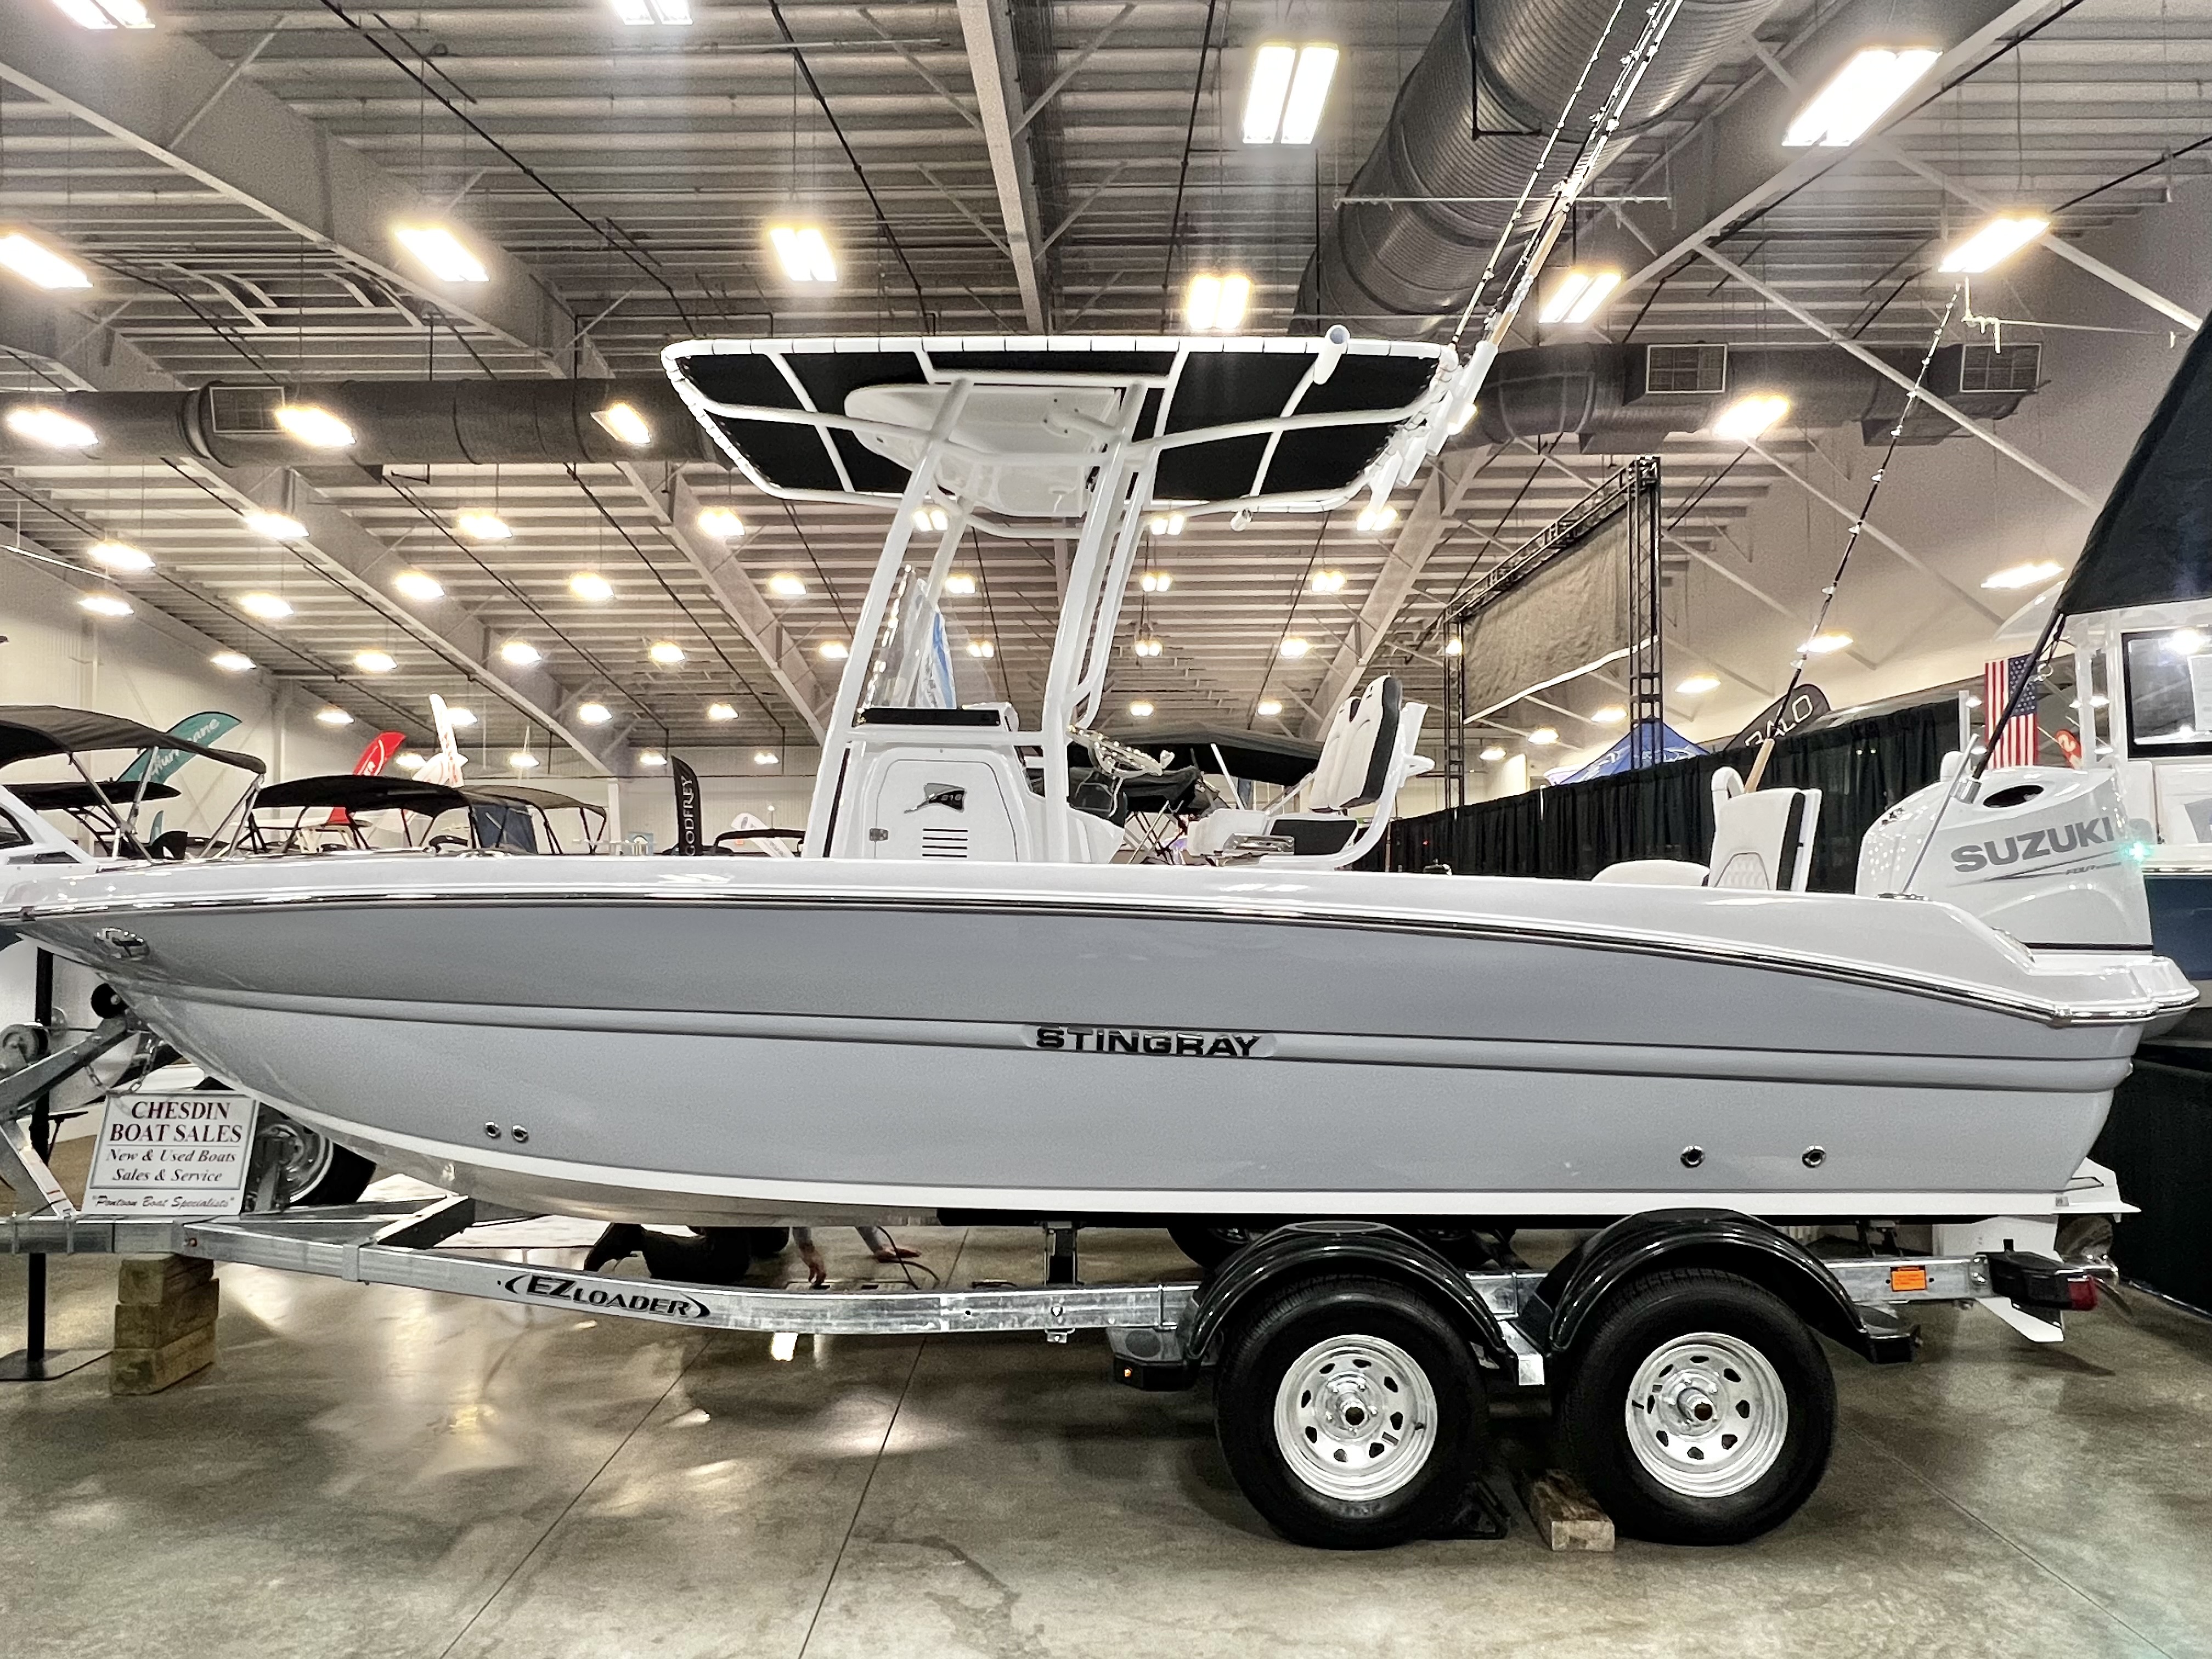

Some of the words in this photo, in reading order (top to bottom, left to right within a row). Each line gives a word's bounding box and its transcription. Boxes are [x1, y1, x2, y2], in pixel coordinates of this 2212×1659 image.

[681, 775, 696, 856] GODFREY
[1950, 815, 2115, 873] SUZUKI
[1036, 1026, 1260, 1057] STINGRAY
[132, 1101, 230, 1119] CHESDIN
[110, 1124, 171, 1142] BOAT
[173, 1124, 242, 1143] SALES
[106, 1149, 138, 1161] New
[142, 1149, 154, 1161] &
[160, 1149, 198, 1162] Used
[198, 1150, 236, 1163] Boats
[112, 1168, 151, 1181] Sales
[154, 1169, 166, 1181] &
[171, 1169, 223, 1182] Service
[143, 1195, 167, 1207] Boat
